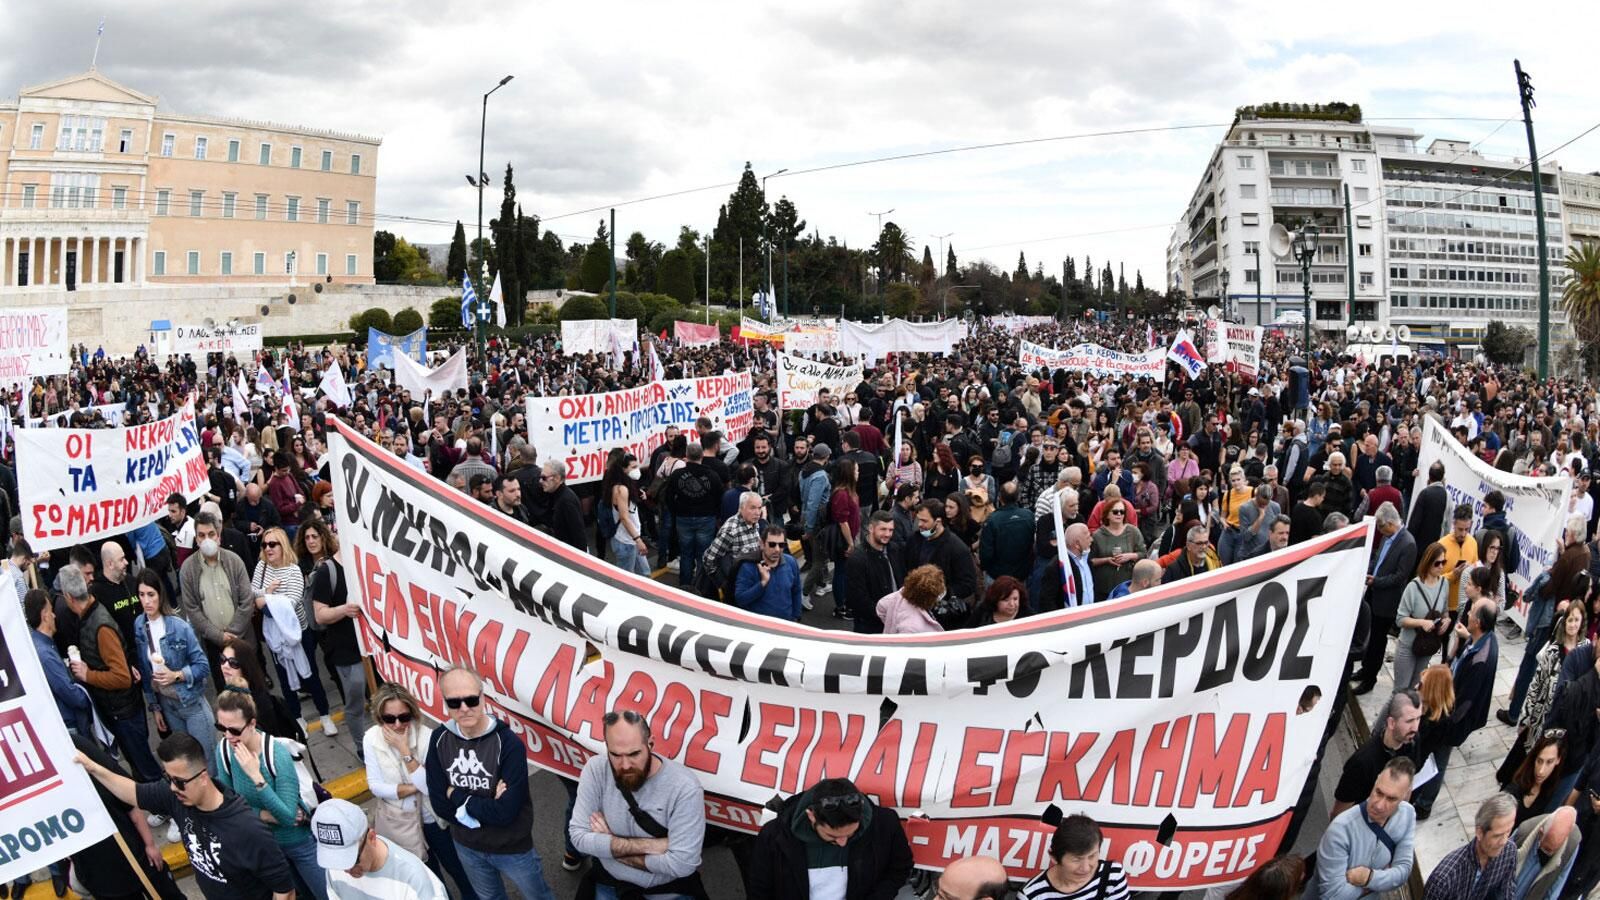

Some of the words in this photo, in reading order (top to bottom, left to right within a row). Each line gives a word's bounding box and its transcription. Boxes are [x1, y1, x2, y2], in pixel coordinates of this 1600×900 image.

[559, 395, 595, 419] ΟΧΙ
[696, 375, 738, 400] ΚΕΡΔΗ
[65, 433, 92, 460] ΟΙ
[563, 416, 622, 446] ΜΕΤΡΑ
[69, 464, 97, 493] ΤΑ
[125, 444, 172, 484] ΚΕΡΔΗ
[32, 495, 138, 539] ΣΩΜΑΤΕΙΟ
[341, 453, 370, 529] ΟΙ
[1068, 576, 1327, 699] ΚΕΡΔΟΣ
[408, 581, 531, 703] ΕΙΝΑΙ
[531, 643, 733, 775] ΛΑΘΟΣ
[741, 702, 938, 809] ΕΙΝΑΙ
[951, 712, 1288, 808] ΕΓΚΛΗΜΑ
[1123, 833, 1266, 879] ΦΟΡΕΙΣ
